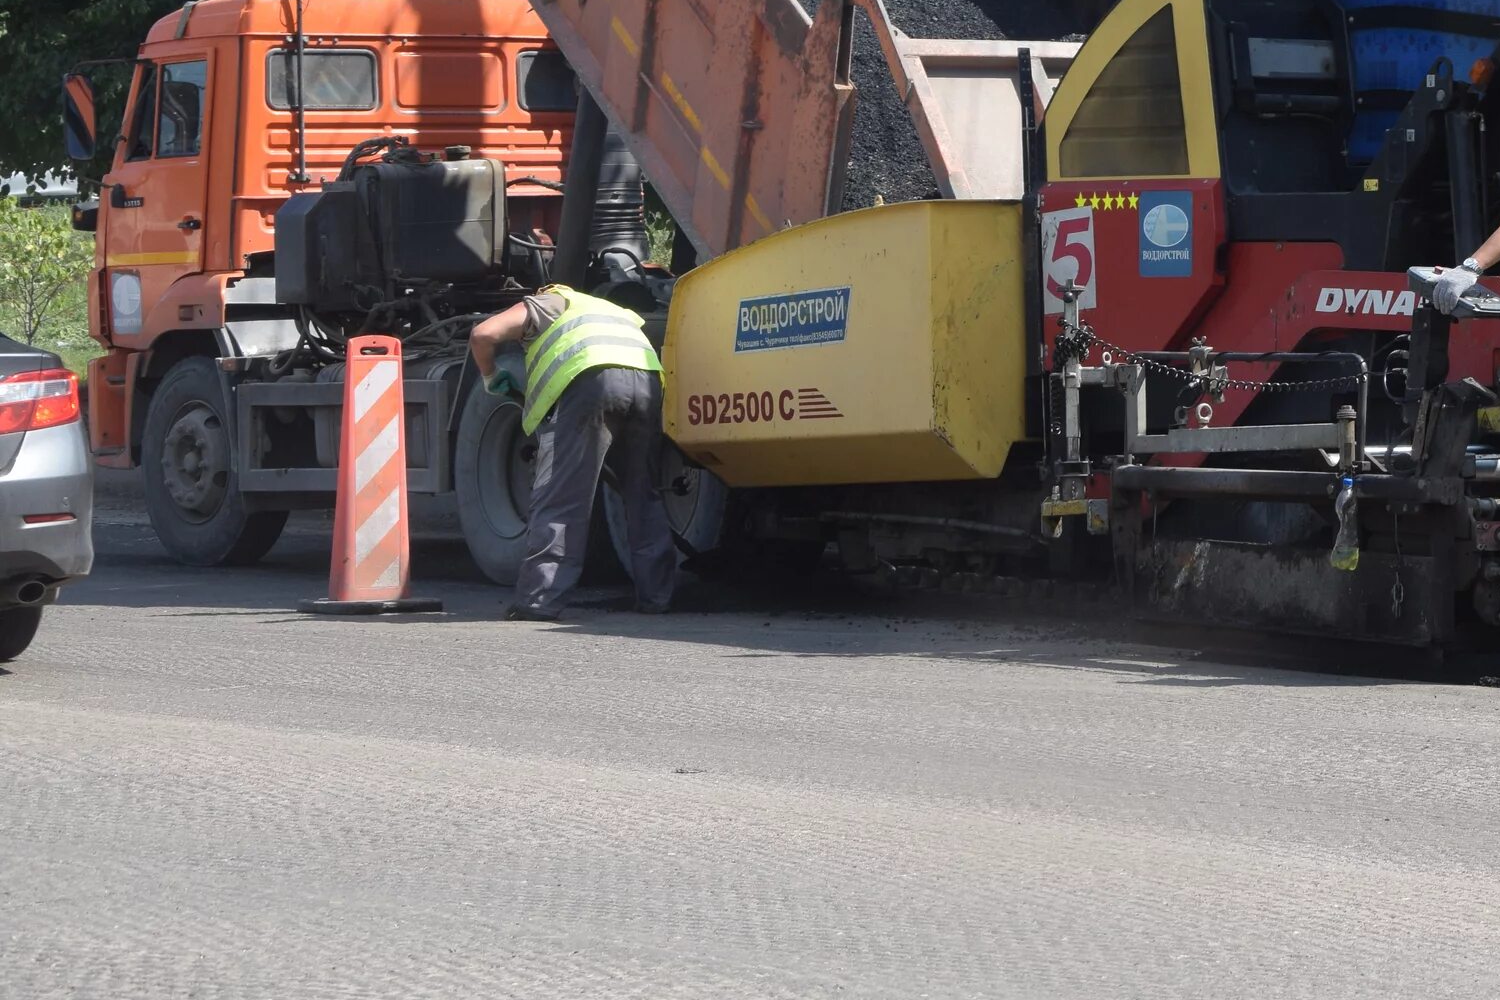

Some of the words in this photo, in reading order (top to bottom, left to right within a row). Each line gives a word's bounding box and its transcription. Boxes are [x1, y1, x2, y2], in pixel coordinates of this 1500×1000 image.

[1047, 216, 1092, 301] 5
[1142, 248, 1190, 262] ВОДДОРСТРОЙ
[741, 290, 845, 334] ВОДДОРСТРОЙ
[1315, 287, 1430, 316] DYNA
[688, 391, 774, 426] SD2500
[779, 389, 795, 421] C
